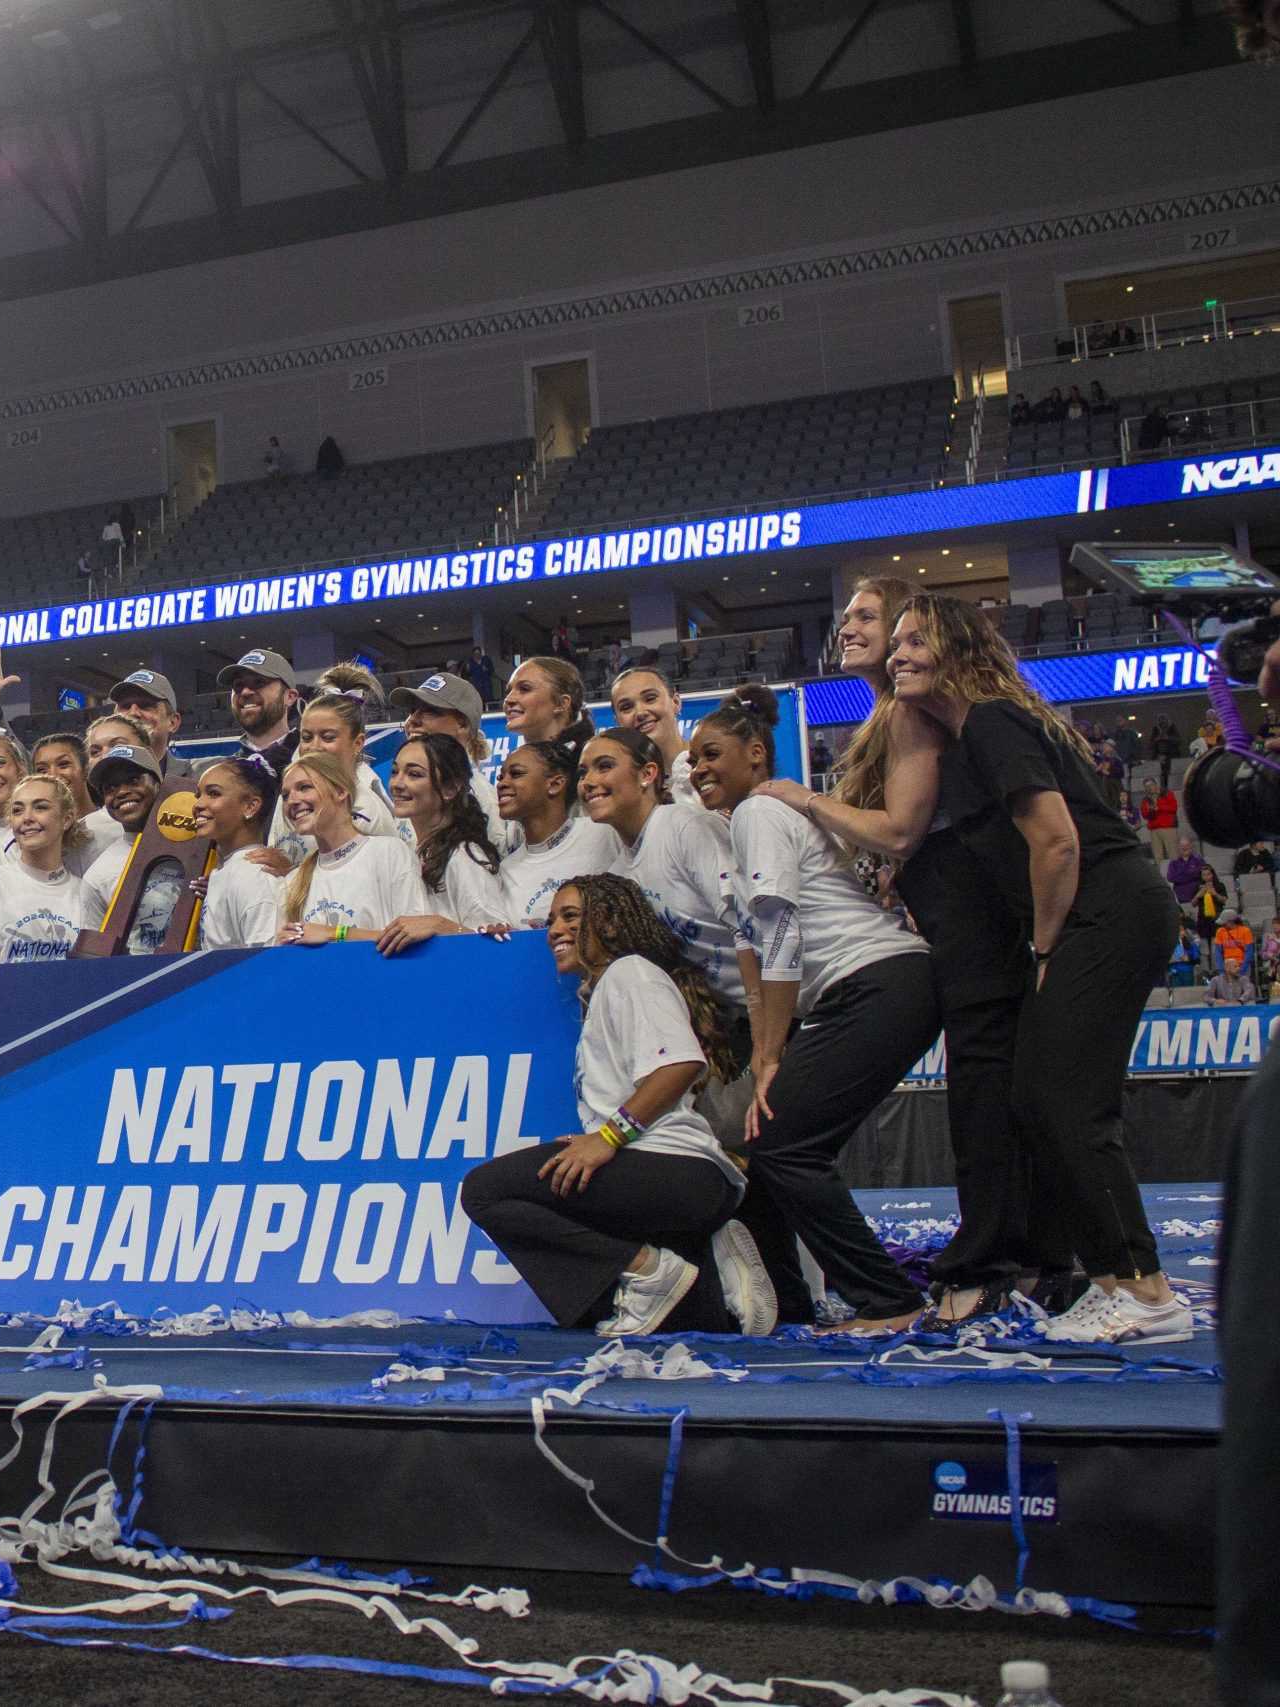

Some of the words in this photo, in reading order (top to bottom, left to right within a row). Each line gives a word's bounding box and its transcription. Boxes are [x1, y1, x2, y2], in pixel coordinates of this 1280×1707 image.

[1190, 230, 1231, 250] 207
[743, 304, 781, 325] 206
[351, 369, 386, 389] 205
[10, 428, 39, 448] 204
[59, 590, 207, 639] COLLEGIATE
[214, 569, 342, 618] WOMEN'S
[350, 546, 535, 601] GYMNASTICS
[543, 510, 803, 576] CHAMPIONSHIPS
[96, 1053, 541, 1165] NATIONAL
[932, 1492, 1057, 1517] GYMNASICS
